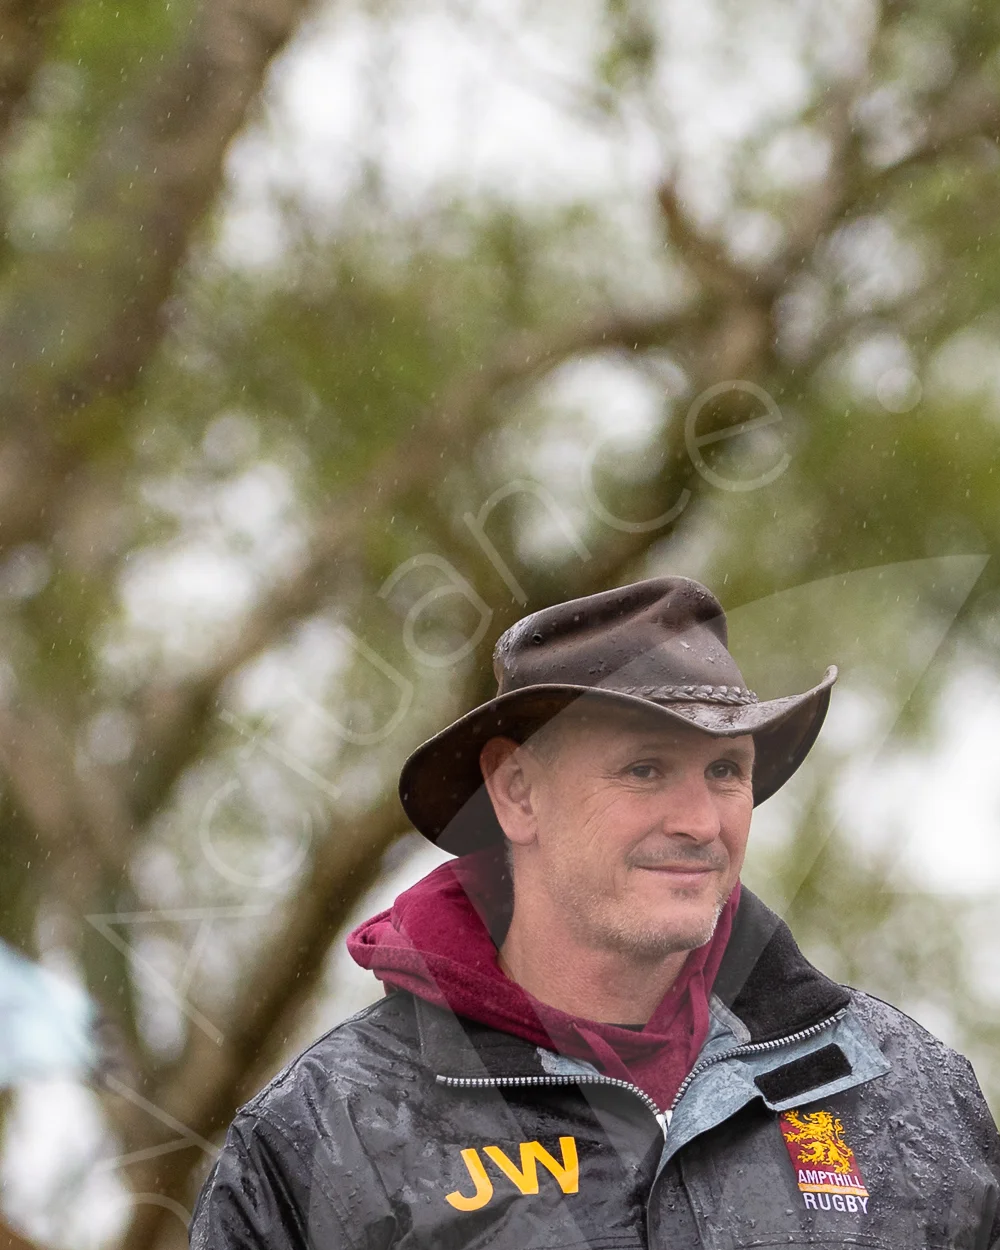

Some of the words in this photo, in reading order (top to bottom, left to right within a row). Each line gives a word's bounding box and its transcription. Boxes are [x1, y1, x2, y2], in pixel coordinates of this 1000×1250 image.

[445, 1136, 580, 1212] JW
[797, 1168, 866, 1190] AMPTHILL
[803, 1192, 870, 1215] RUGBY
